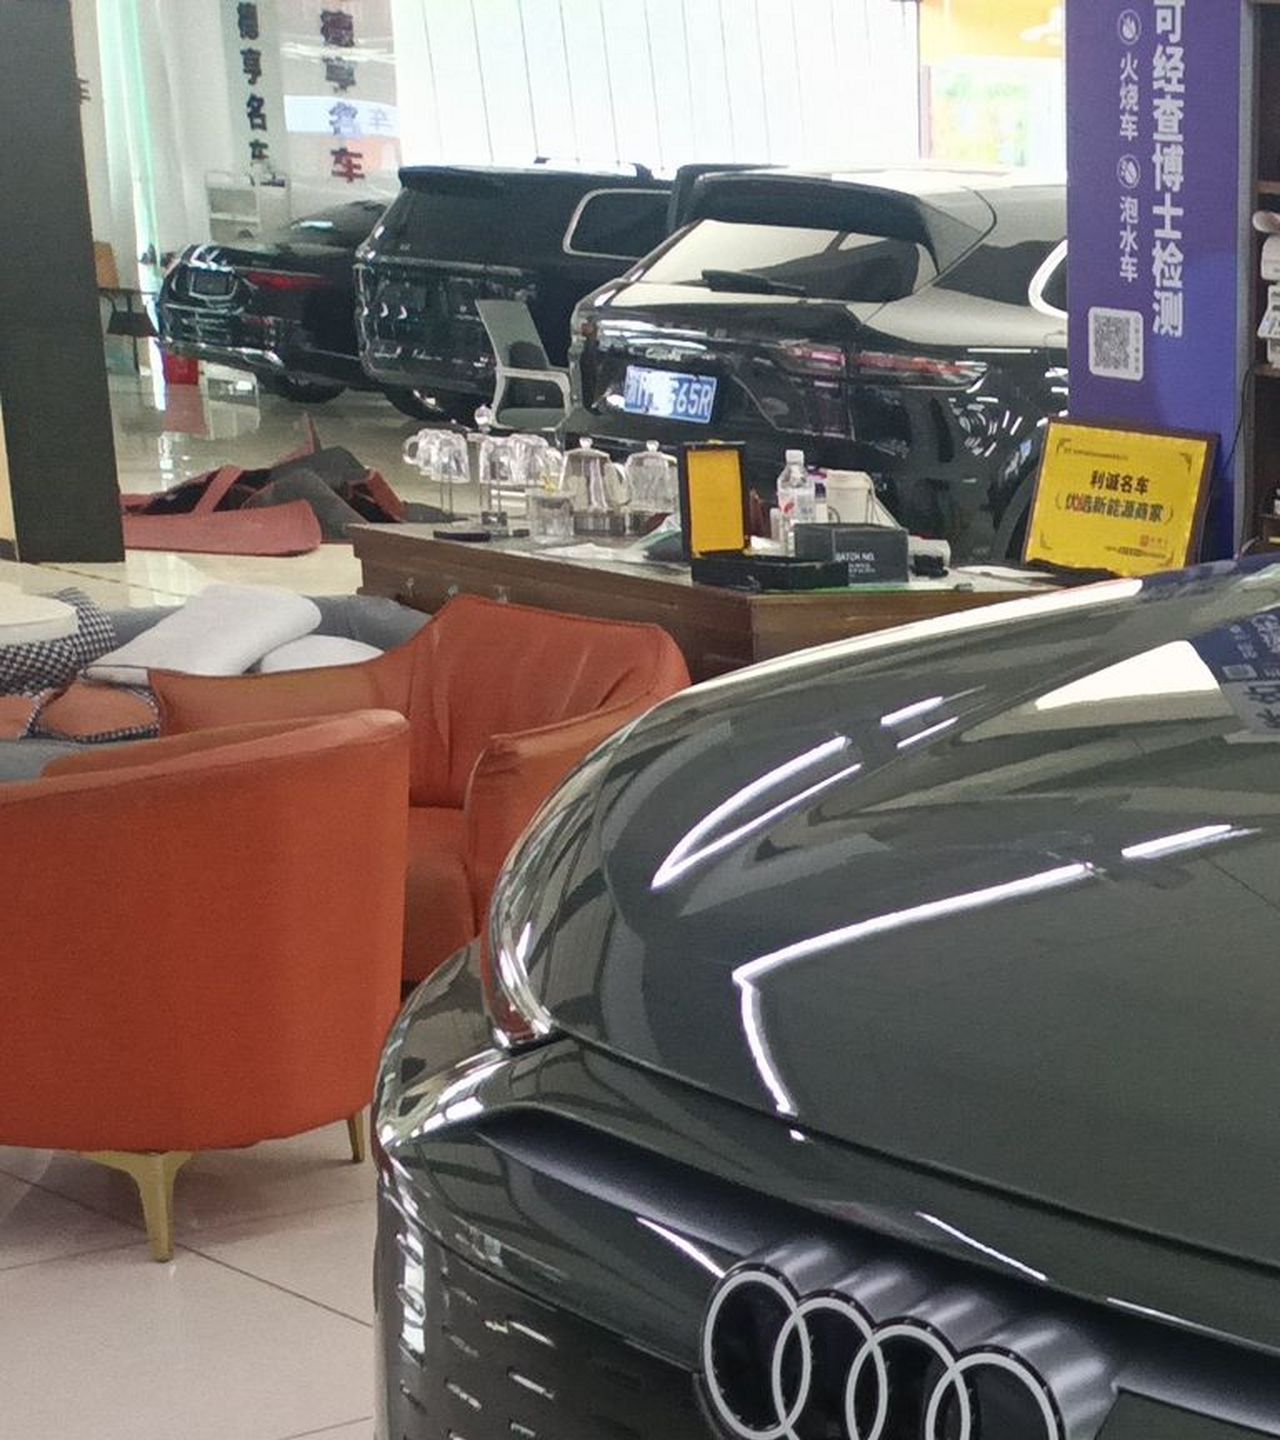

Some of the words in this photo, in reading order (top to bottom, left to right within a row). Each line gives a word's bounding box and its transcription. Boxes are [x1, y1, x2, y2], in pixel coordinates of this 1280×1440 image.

[1119, 52, 1139, 142] 火烧车
[1152, 0, 1185, 338] 可经查博士检测
[1119, 196, 1139, 283] 泡水车
[1090, 470, 1151, 495] 利诚名车
